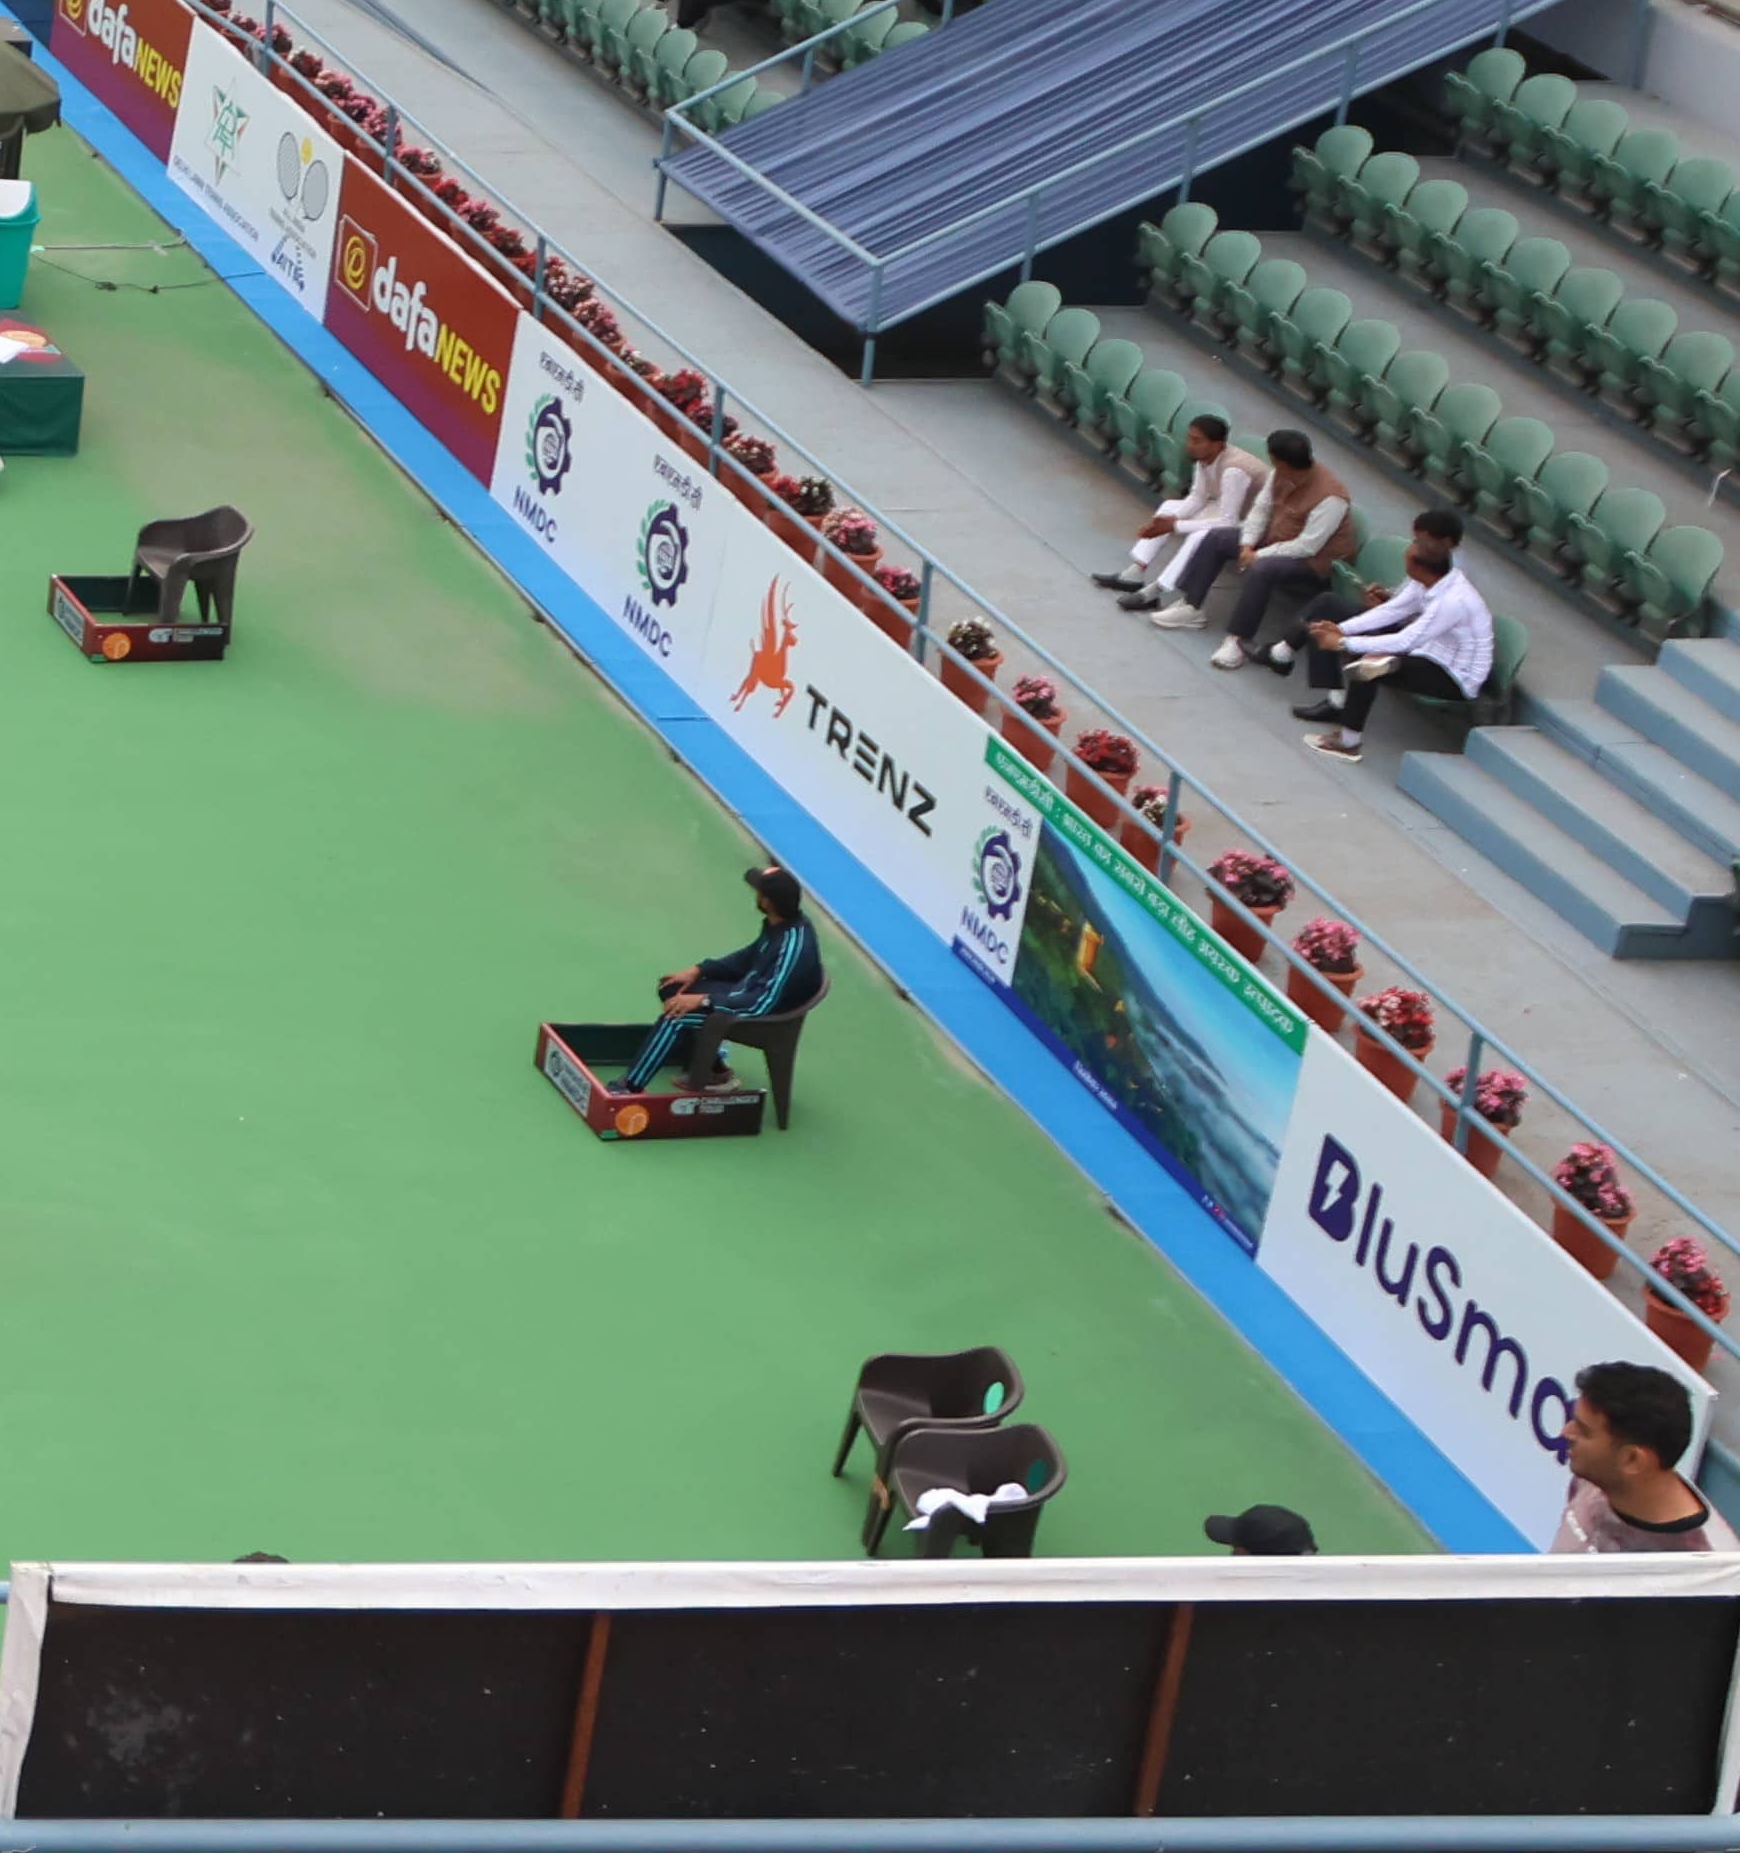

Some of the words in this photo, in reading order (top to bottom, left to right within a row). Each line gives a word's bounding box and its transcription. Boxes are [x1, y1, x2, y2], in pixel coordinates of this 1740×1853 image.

[374, 256, 502, 415] dafaNEWS
[514, 488, 556, 543] NMDC
[623, 594, 672, 657] NMDC
[805, 685, 936, 837] TRENZ
[962, 906, 1009, 964] NMDC
[1308, 1132, 1577, 1466] BluSma
